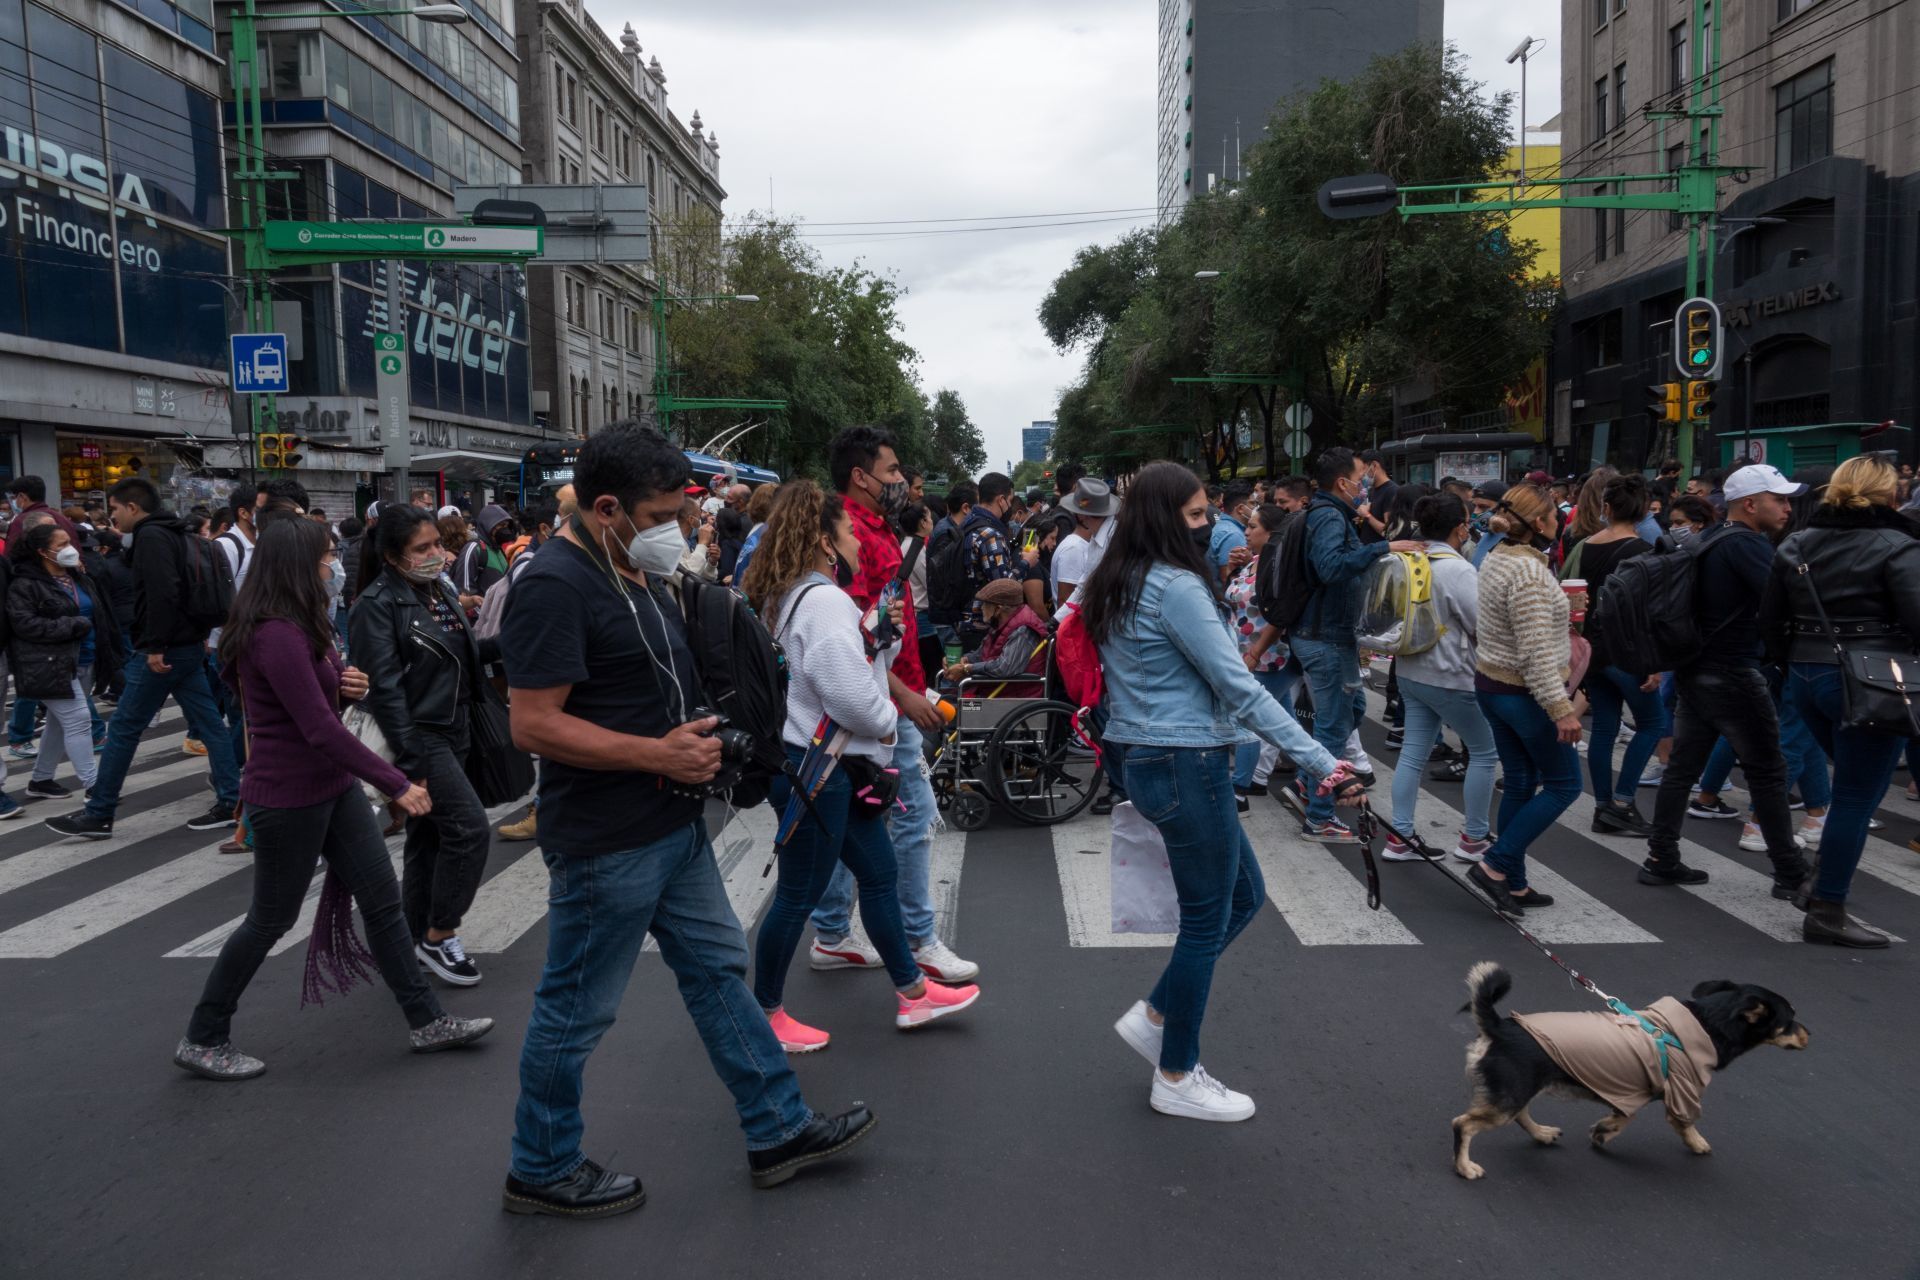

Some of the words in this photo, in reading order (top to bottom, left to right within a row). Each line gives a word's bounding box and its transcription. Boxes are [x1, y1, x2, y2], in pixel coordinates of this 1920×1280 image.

[16, 197, 161, 272] Financero
[450, 235, 477, 243] Madero
[414, 276, 516, 377] telcel
[136, 387, 153, 397] MINI
[390, 396, 400, 439] Madero
